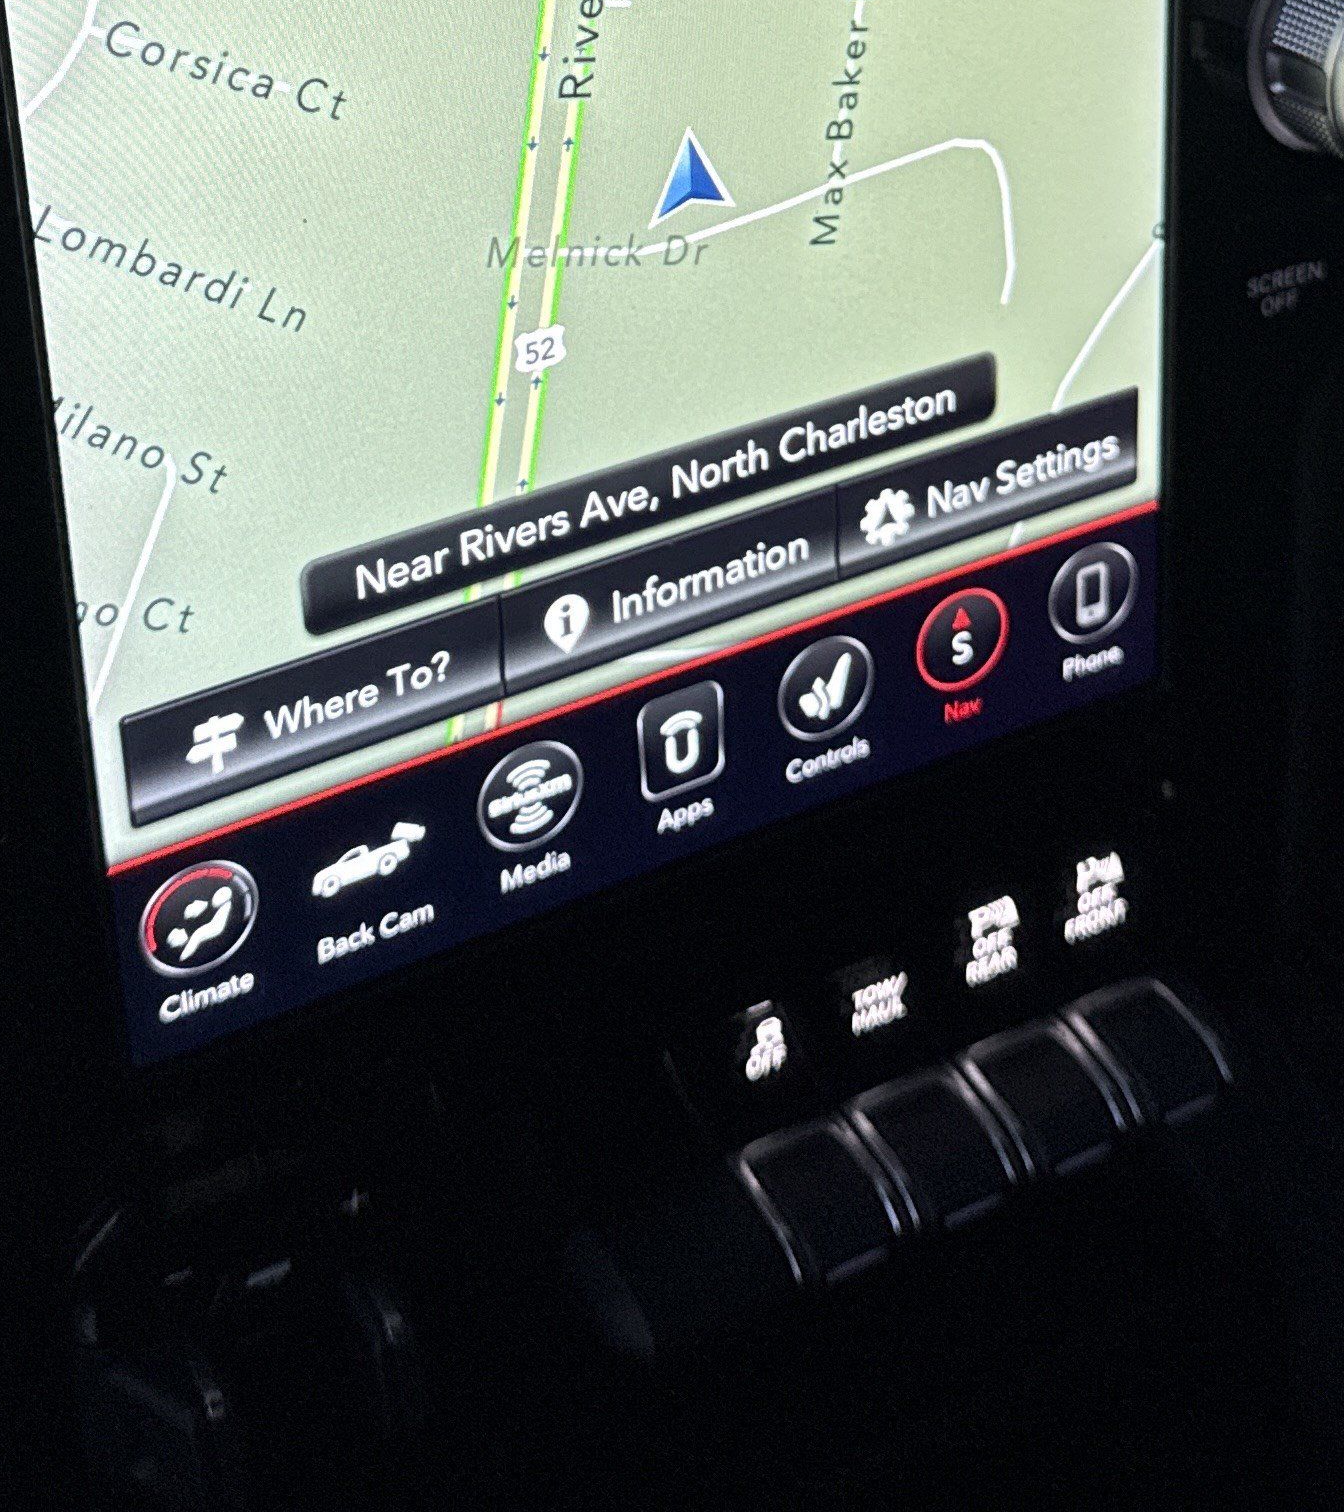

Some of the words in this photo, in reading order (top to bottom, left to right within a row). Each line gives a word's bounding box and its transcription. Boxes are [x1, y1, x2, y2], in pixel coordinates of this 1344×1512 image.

[104, 20, 276, 100] Corsica
[295, 77, 348, 121] Ct
[825, 19, 870, 141] Baker
[809, 158, 850, 245] Max
[33, 203, 252, 312] Lombardi
[258, 286, 307, 333] Ln
[486, 234, 643, 269] Melnick
[662, 236, 709, 267] Dr
[1247, 260, 1326, 299] SCREEN
[524, 335, 557, 365] 52
[180, 451, 229, 496] St
[356, 546, 450, 600] Near
[460, 508, 571, 567] Rivers
[580, 481, 661, 534] Ave,
[670, 439, 770, 502] North
[778, 383, 957, 465] Charleston
[926, 471, 991, 520] Nav
[996, 433, 1121, 493] Settings
[612, 535, 810, 625] Information
[143, 597, 195, 634] Ct
[1062, 643, 1125, 682] Phone
[263, 678, 380, 740] Where
[386, 650, 452, 698] To?
[944, 695, 983, 724] Nav
[785, 735, 872, 784] Controls
[656, 794, 715, 835] Apps
[500, 850, 573, 894] Media
[316, 923, 375, 966] Back
[379, 901, 436, 939] Cam
[158, 970, 256, 1024] Climate
